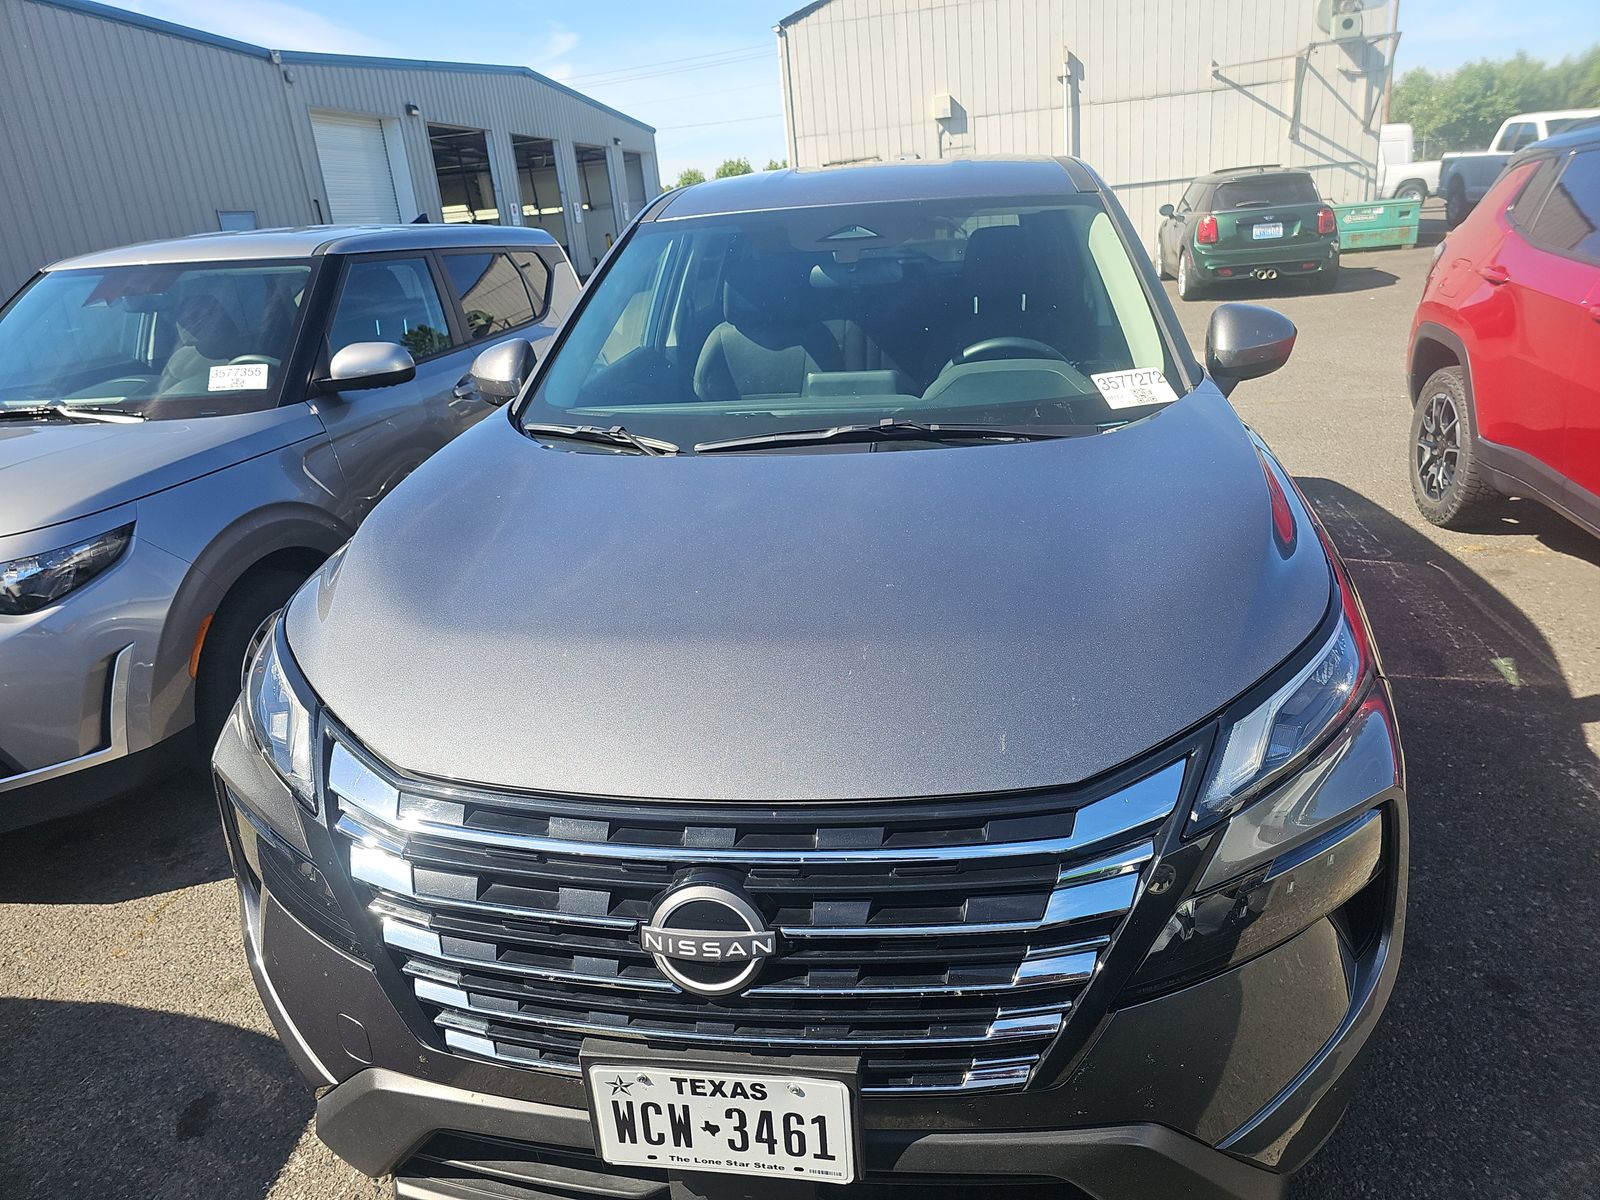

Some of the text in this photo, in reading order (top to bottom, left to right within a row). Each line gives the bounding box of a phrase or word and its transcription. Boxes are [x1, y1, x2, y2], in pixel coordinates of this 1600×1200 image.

[211, 367, 262, 379] 3577355
[1097, 370, 1167, 391] 3577272
[644, 932, 773, 956] NISSAN
[669, 1077, 768, 1101] TEXAS
[611, 1099, 836, 1162] WCW 3461
[669, 1154, 785, 1171] The Lone Star State
